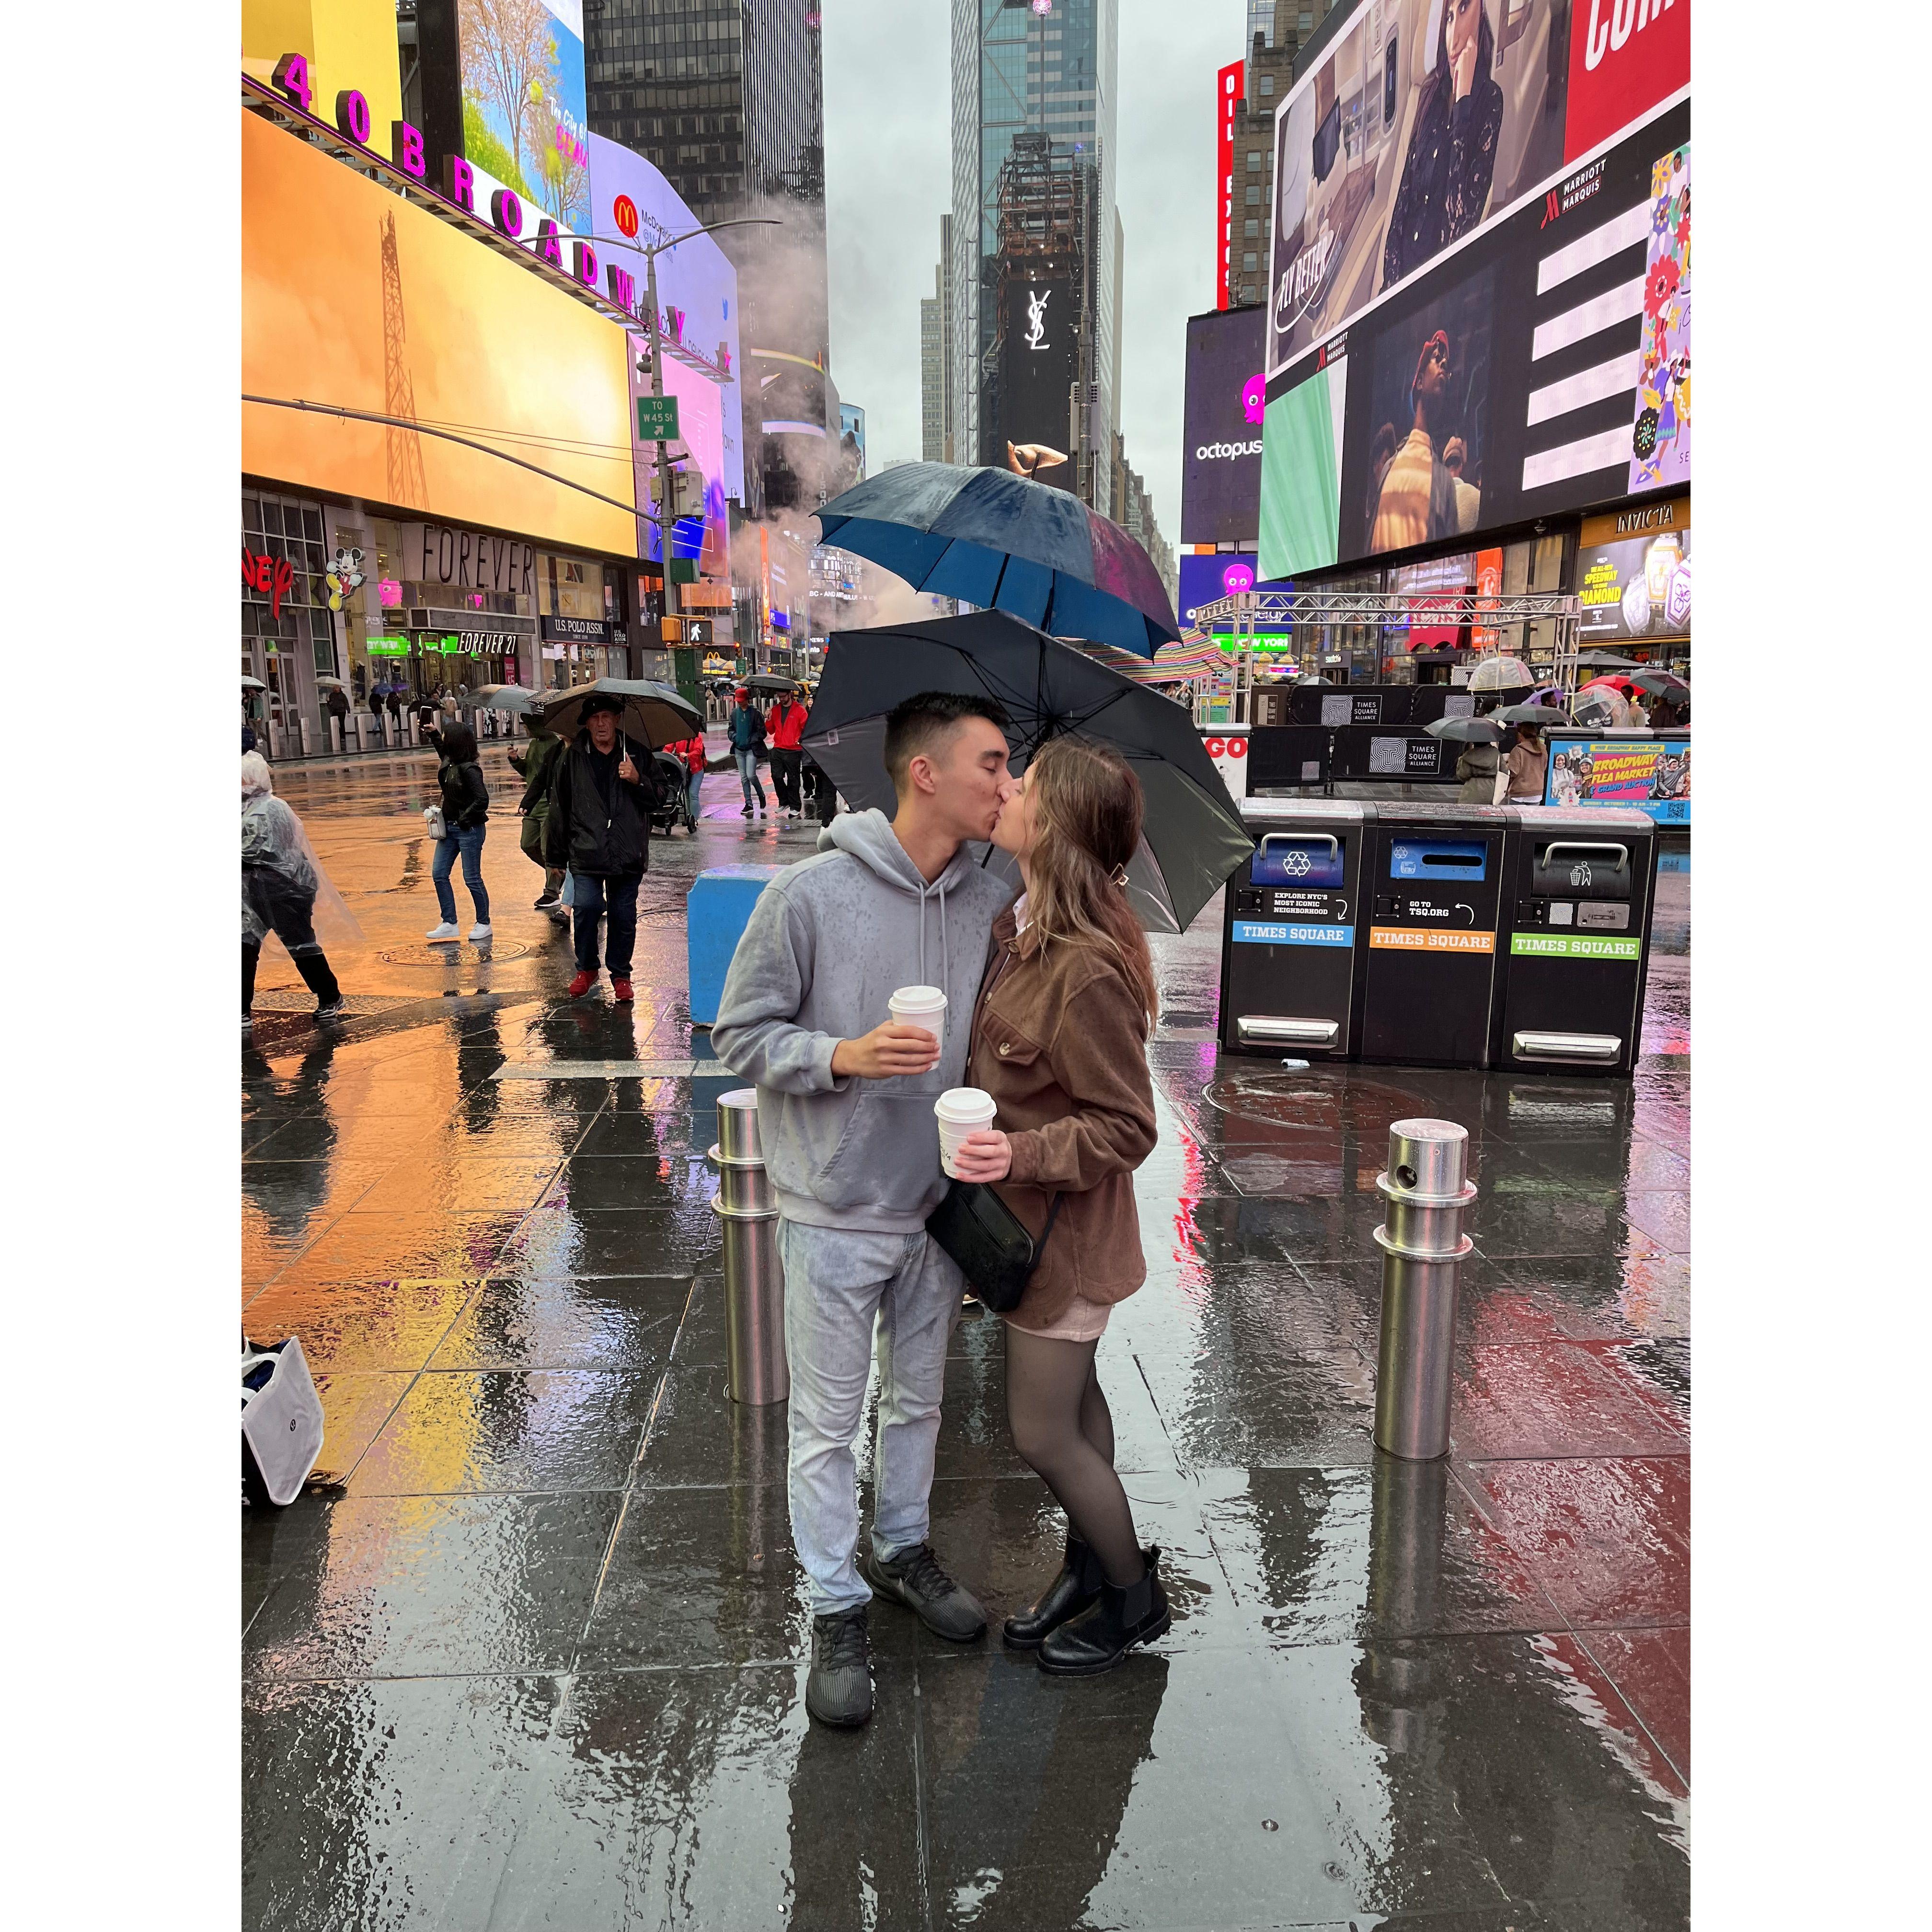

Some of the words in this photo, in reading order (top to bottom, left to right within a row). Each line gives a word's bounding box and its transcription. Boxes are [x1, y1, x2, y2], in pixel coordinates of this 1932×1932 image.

[1564, 159, 1607, 196] MARRIOTT
[1563, 179, 1600, 211] MARQUIS
[397, 120, 685, 344] BROADWY
[1279, 264, 1295, 312] FLY
[1327, 331, 1348, 352] MARRIOTT
[1327, 344, 1345, 362] MARQUIS
[652, 401, 663, 411] TO
[643, 414, 650, 423] W
[652, 414, 663, 423] 45
[665, 414, 673, 422] St
[1196, 439, 1263, 461] octopus
[1615, 505, 1673, 534] INVICTA
[422, 522, 533, 595] FOREVER
[1584, 570, 1618, 585] SPEEDWAY
[1579, 586, 1622, 605] DIAMOND
[555, 619, 567, 632] U.S.
[568, 620, 586, 633] POLO
[586, 622, 604, 635] ASSN.
[459, 632, 504, 654] FOREVER
[506, 635, 516, 655] 21
[1408, 753, 1437, 761] SQUARE
[1593, 754, 1658, 772] BROADWAY
[1591, 772, 1614, 784] FLEA
[1615, 767, 1656, 782] MARKET
[1598, 782, 1623, 794] GRAND
[1624, 777, 1656, 790] AUCTION
[1409, 908, 1449, 917] TSQ.ORG
[1243, 926, 1287, 939] TIMES
[1290, 928, 1345, 942] SQUARE
[1374, 934, 1424, 946] TIMES
[1428, 935, 1491, 949] SQUARE
[1515, 939, 1567, 951] TIMES
[1571, 941, 1635, 955] SQUARE
